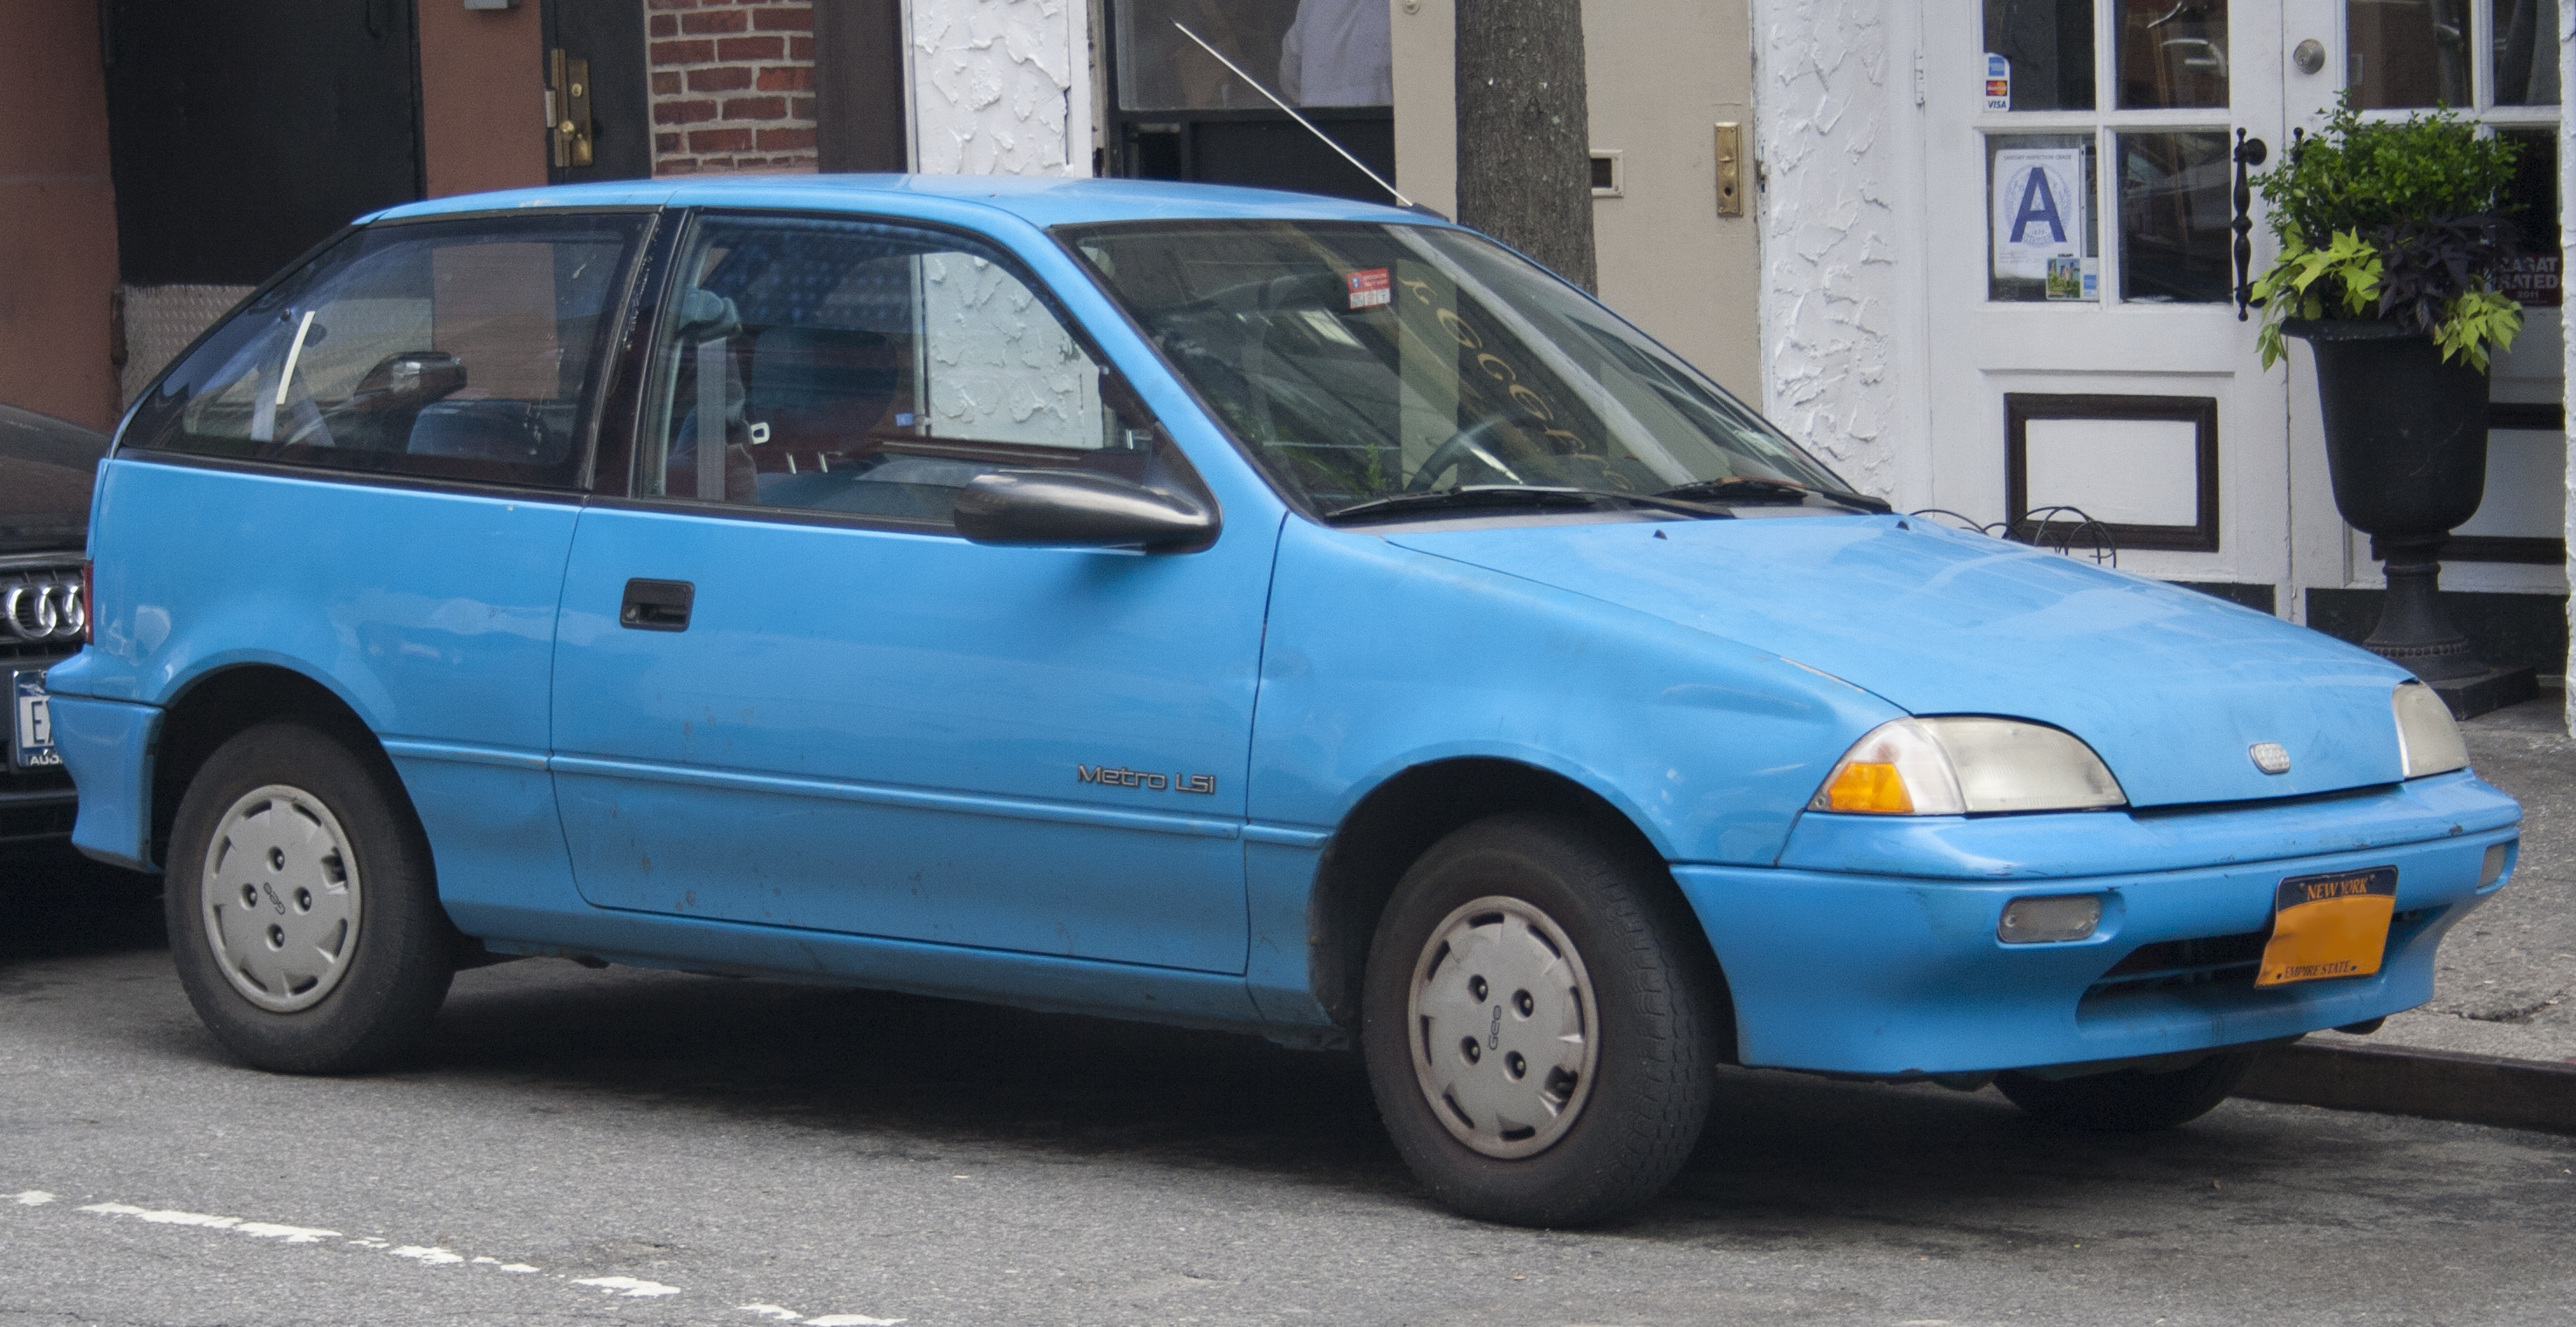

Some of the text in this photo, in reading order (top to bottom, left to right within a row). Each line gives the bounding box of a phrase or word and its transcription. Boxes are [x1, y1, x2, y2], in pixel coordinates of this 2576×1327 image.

[1988, 100, 2007, 109] VISA
[2010, 167, 2068, 243] A
[1077, 764, 1168, 790] Metro
[2307, 878, 2368, 900] NEW YORK
[2285, 961, 2351, 978] EMPIRE STATE
